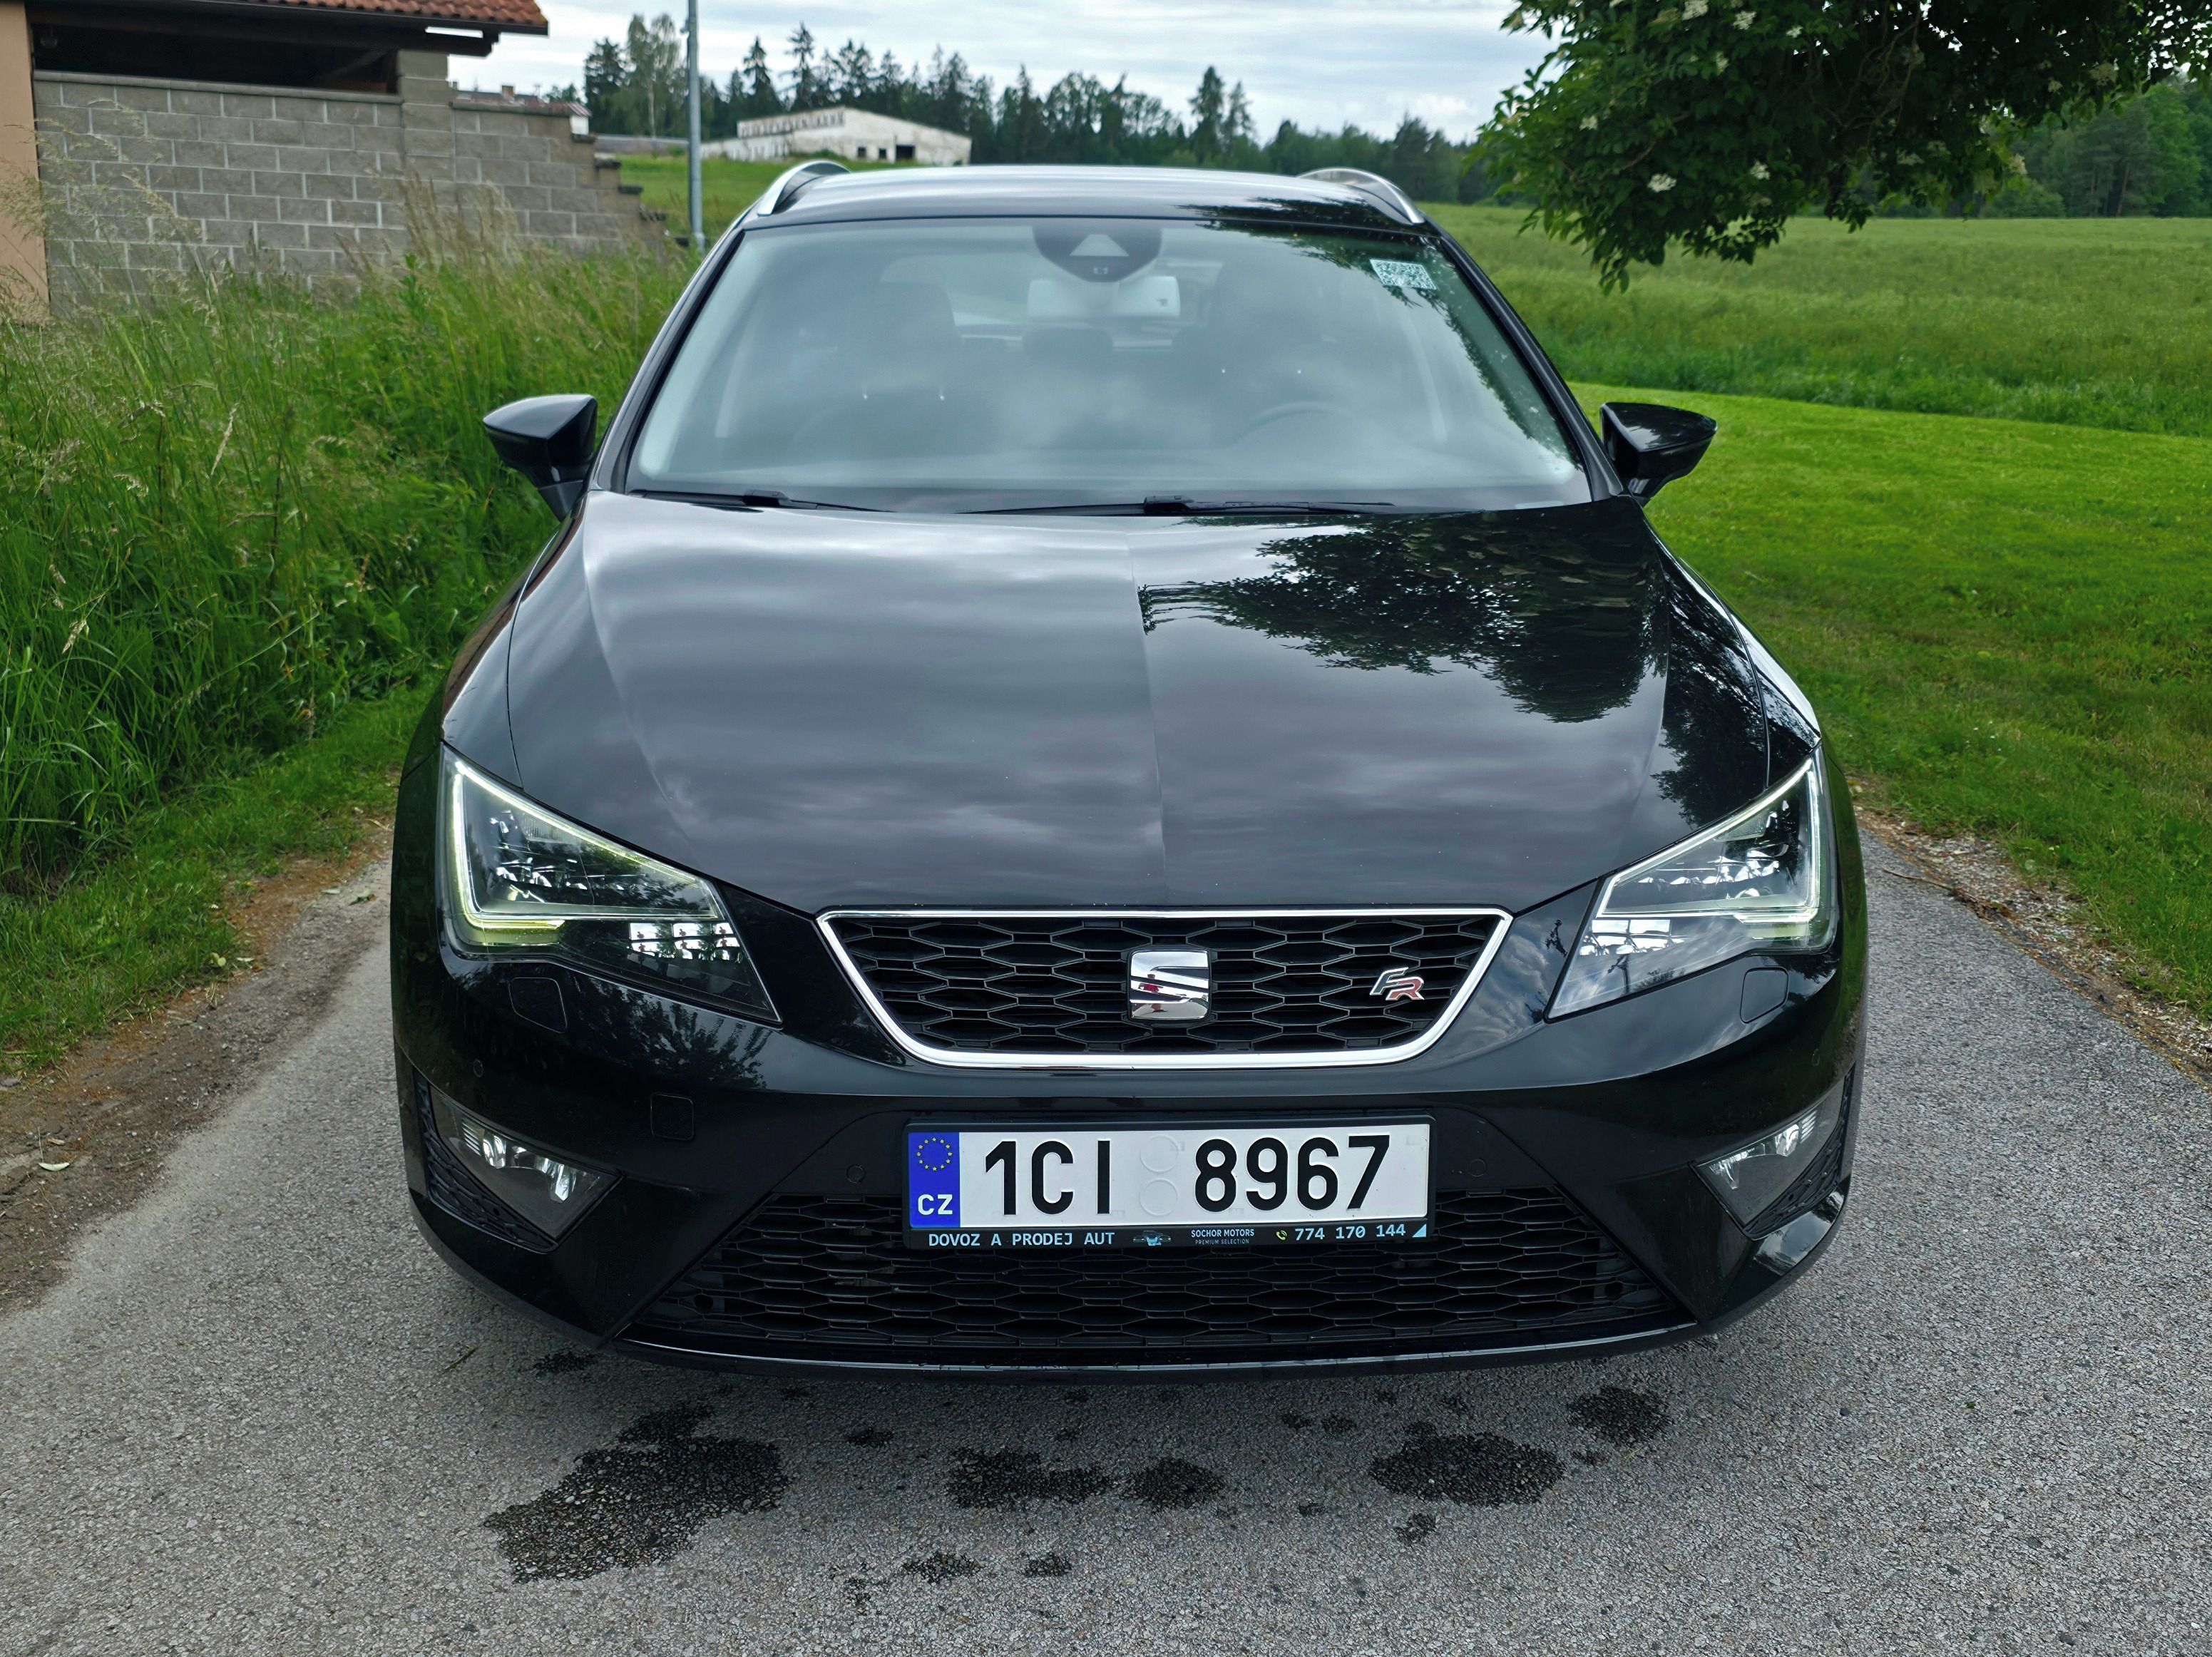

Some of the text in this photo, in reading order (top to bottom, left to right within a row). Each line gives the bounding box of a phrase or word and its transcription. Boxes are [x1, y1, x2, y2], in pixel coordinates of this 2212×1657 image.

[1369, 967, 1425, 1001] FR
[985, 1134, 1391, 1216] 1CI 8967
[917, 1194, 953, 1216] CZ
[928, 1232, 1115, 1246] DOVOZ A PRODEJ AUT
[1191, 1228, 1254, 1238] SOCHOR MOTORS
[1294, 1223, 1406, 1241] 774 170 144
